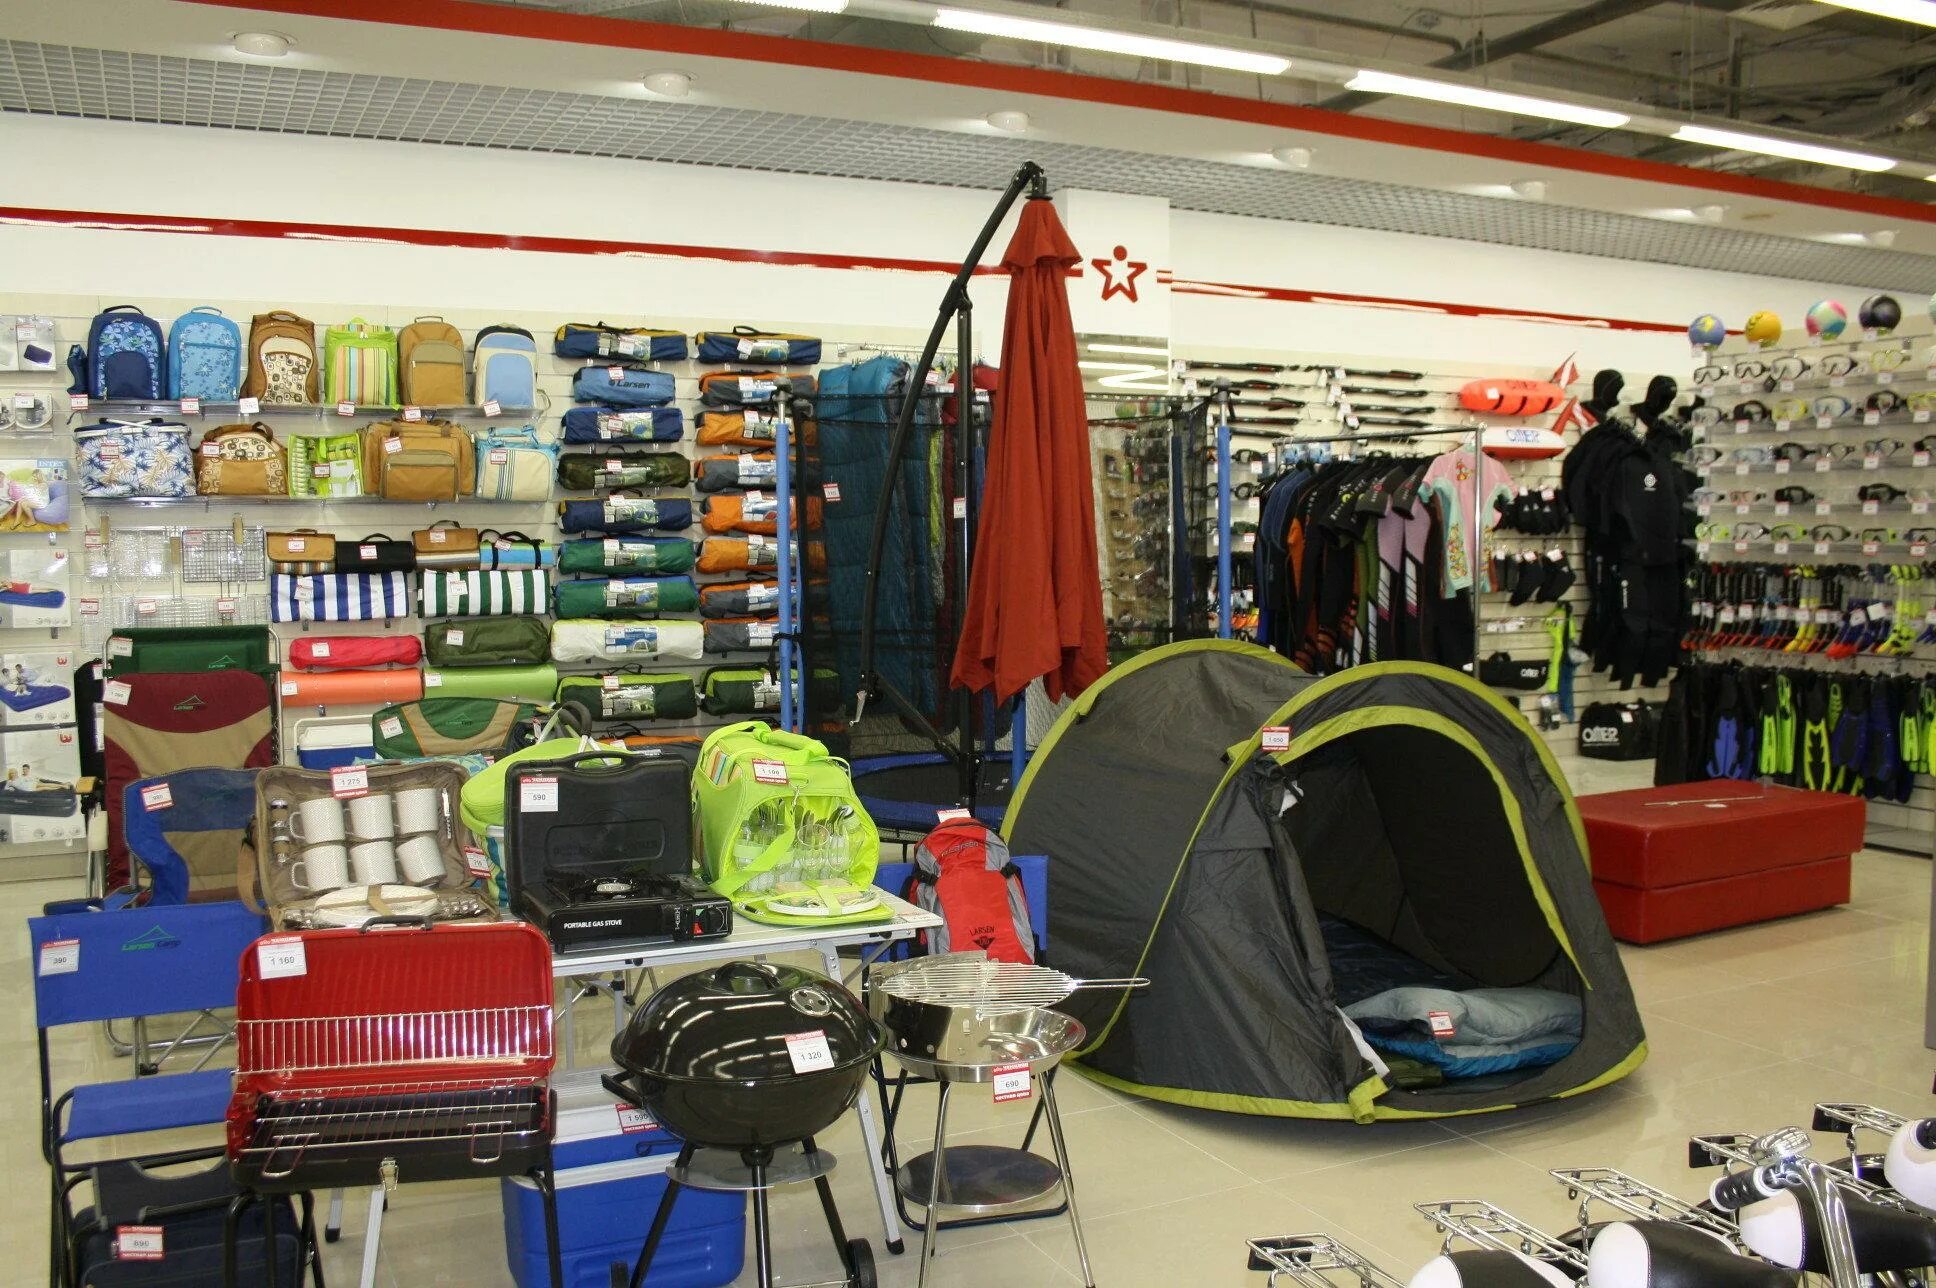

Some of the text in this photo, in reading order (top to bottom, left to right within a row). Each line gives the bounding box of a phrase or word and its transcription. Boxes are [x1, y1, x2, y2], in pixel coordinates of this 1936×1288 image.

[617, 379, 651, 390] Larsen
[39, 460, 66, 468] INTEX
[564, 918, 623, 930] PORTABLE GAS STOVE
[969, 925, 995, 937] LARSEN
[53, 956, 68, 965] 390
[808, 1051, 823, 1060] 320
[1005, 1079, 1020, 1088] 690
